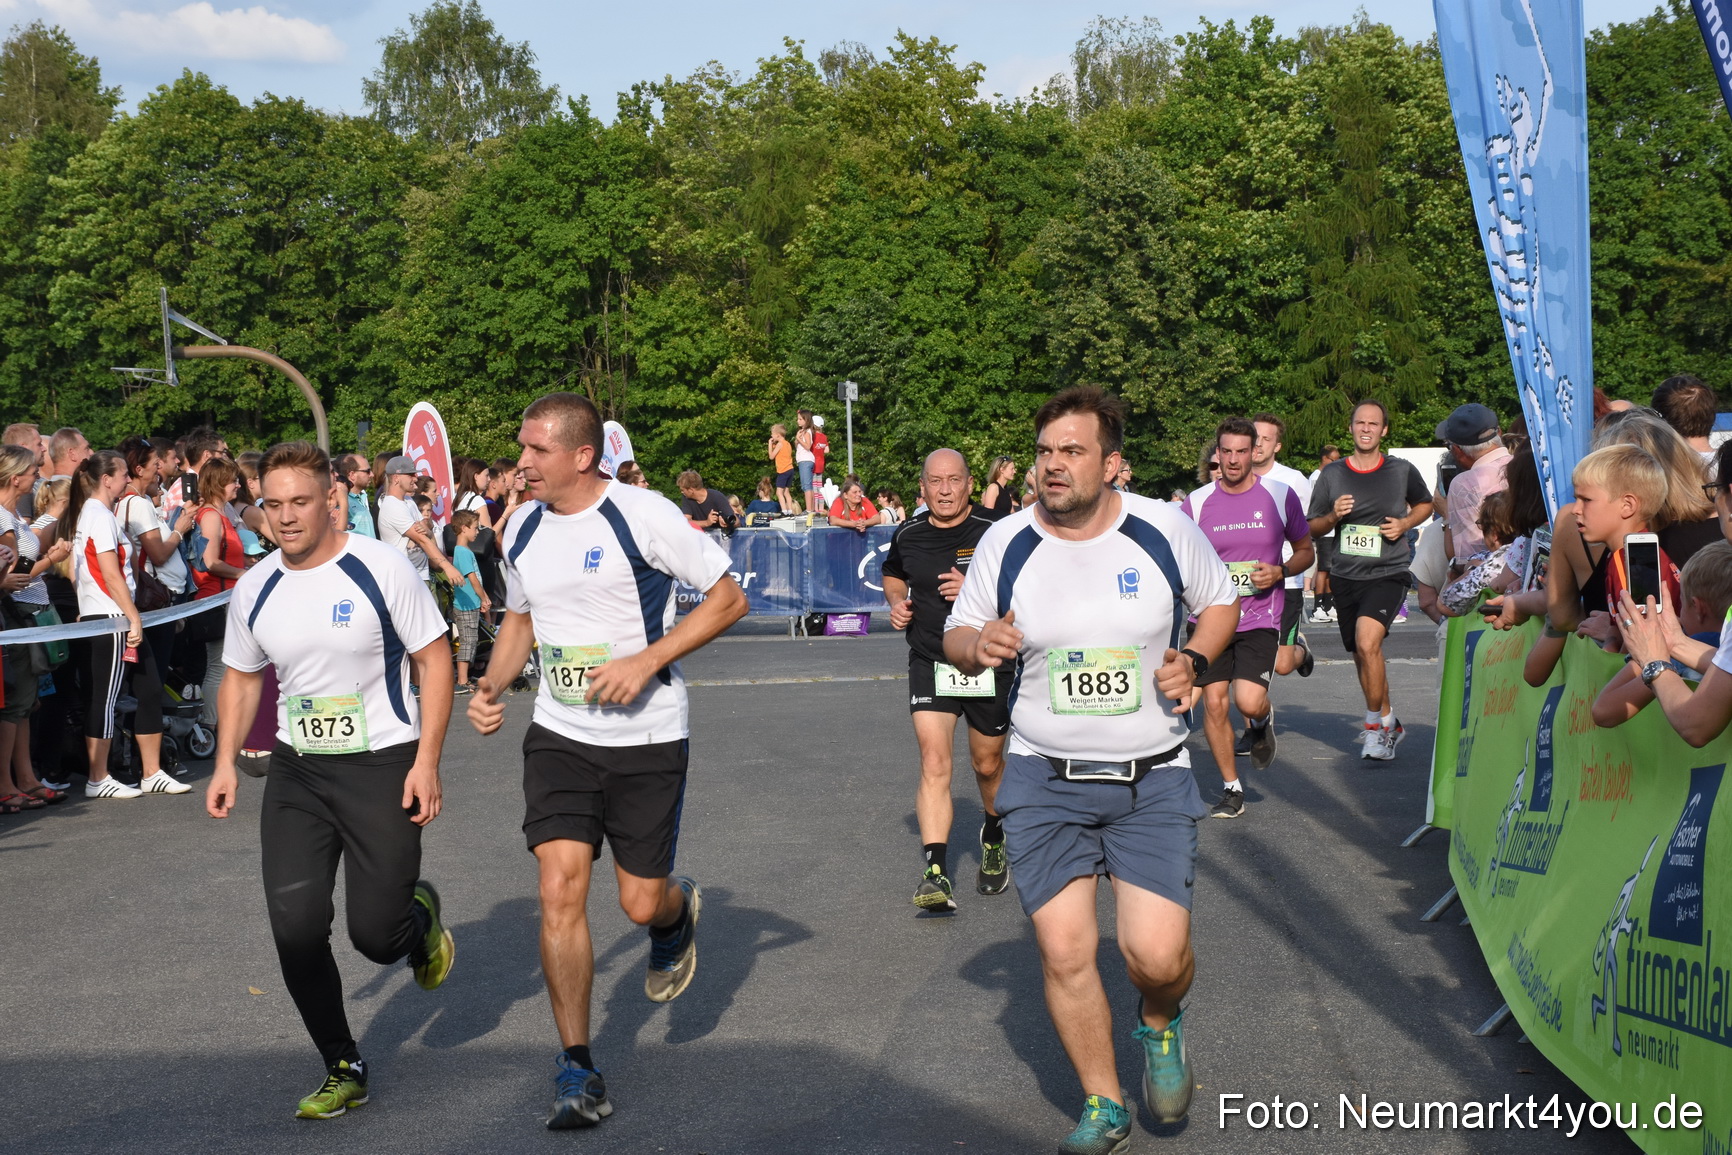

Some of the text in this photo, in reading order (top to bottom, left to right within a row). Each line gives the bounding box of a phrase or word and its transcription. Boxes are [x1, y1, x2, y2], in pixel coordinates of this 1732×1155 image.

[1247, 521, 1266, 529] LILA.
[1346, 535, 1374, 548] 1481
[551, 666, 600, 687] 187
[1061, 671, 1130, 696] 1883
[298, 715, 355, 738] 1873
[1505, 799, 1569, 871] firmenlauf
[1672, 819, 1702, 848] Fischer
[1669, 853, 1694, 867] AUTOMOBILE
[1627, 917, 1732, 1038] firmenlau
[1627, 1029, 1680, 1071] neumarkt
